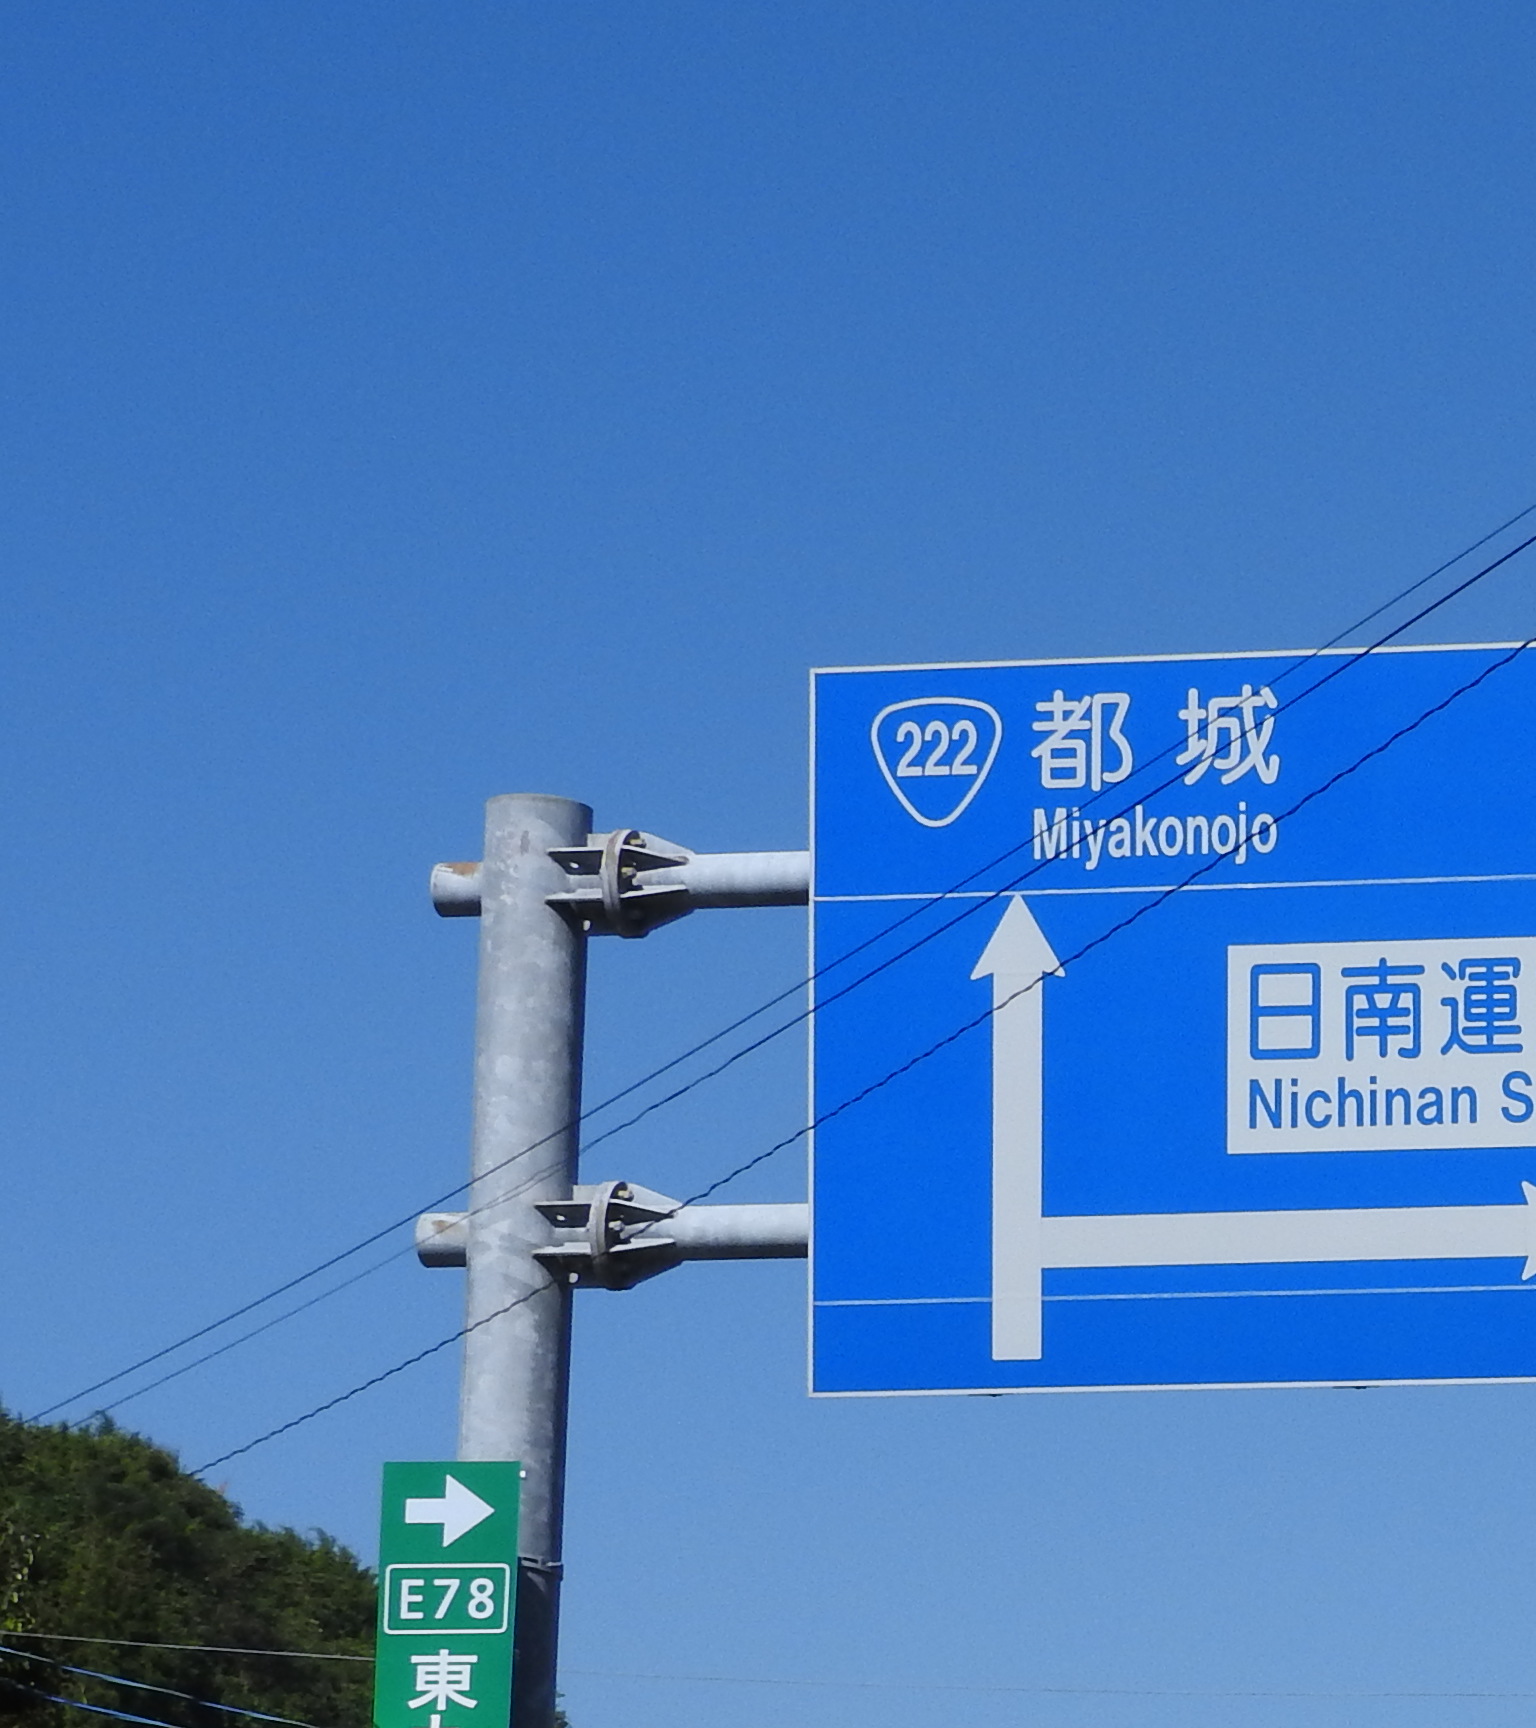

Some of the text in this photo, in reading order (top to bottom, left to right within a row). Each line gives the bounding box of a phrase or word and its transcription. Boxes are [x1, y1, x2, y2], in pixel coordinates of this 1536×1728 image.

[895, 720, 978, 778] 222
[1031, 684, 1281, 791] 都城
[1033, 803, 1279, 871] Miyakonojo
[1247, 1076, 1479, 1131] Nichinan
[399, 1577, 496, 1620] E78
